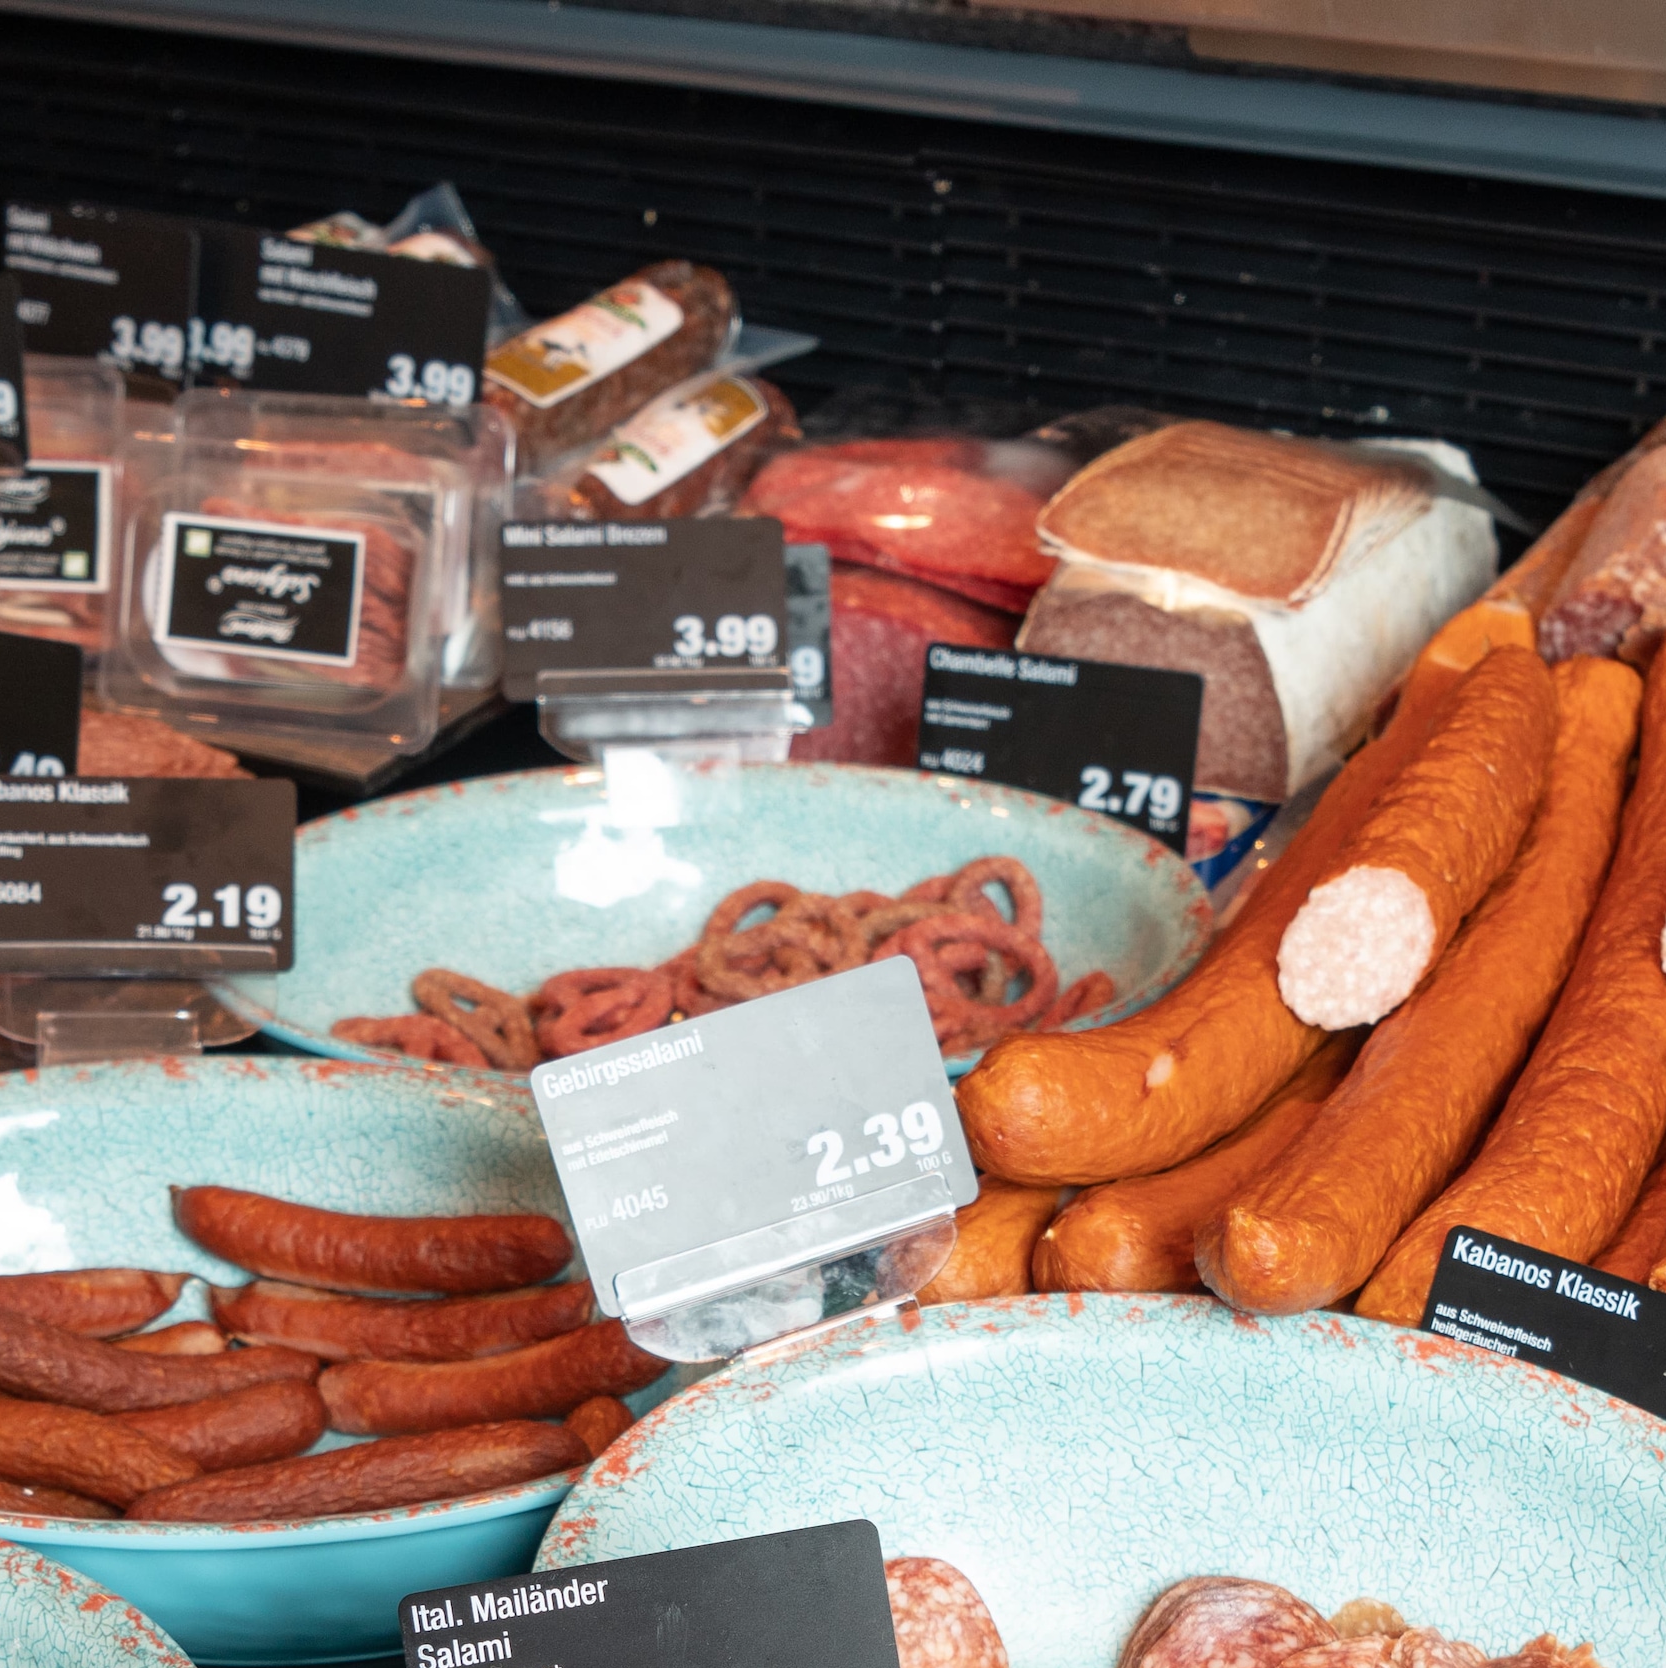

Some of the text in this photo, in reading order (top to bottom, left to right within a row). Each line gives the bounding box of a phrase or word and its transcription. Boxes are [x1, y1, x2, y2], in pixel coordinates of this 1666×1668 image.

[109, 317, 184, 369] 3.99
[384, 355, 473, 406] 3.99
[503, 524, 667, 546] Mini Salami Brezen
[671, 614, 777, 659] 3.99
[57, 780, 129, 803] Klassik
[1076, 766, 1180, 820] 2.79
[159, 883, 281, 930] 2.19
[541, 1027, 704, 1099] Gebirgssalami
[560, 1108, 679, 1156] aus Schweinefleisch
[806, 1100, 947, 1189] 2.39
[582, 1184, 668, 1232] PLU 4045
[789, 1182, 858, 1212] 23.90/1kg
[1451, 1234, 1640, 1320] Kabanos Klassik
[1431, 1318, 1517, 1357] heißgeräuchert
[1434, 1302, 1552, 1352] aus Schweinefleisch
[410, 1577, 608, 1633] Ital. Mailänder
